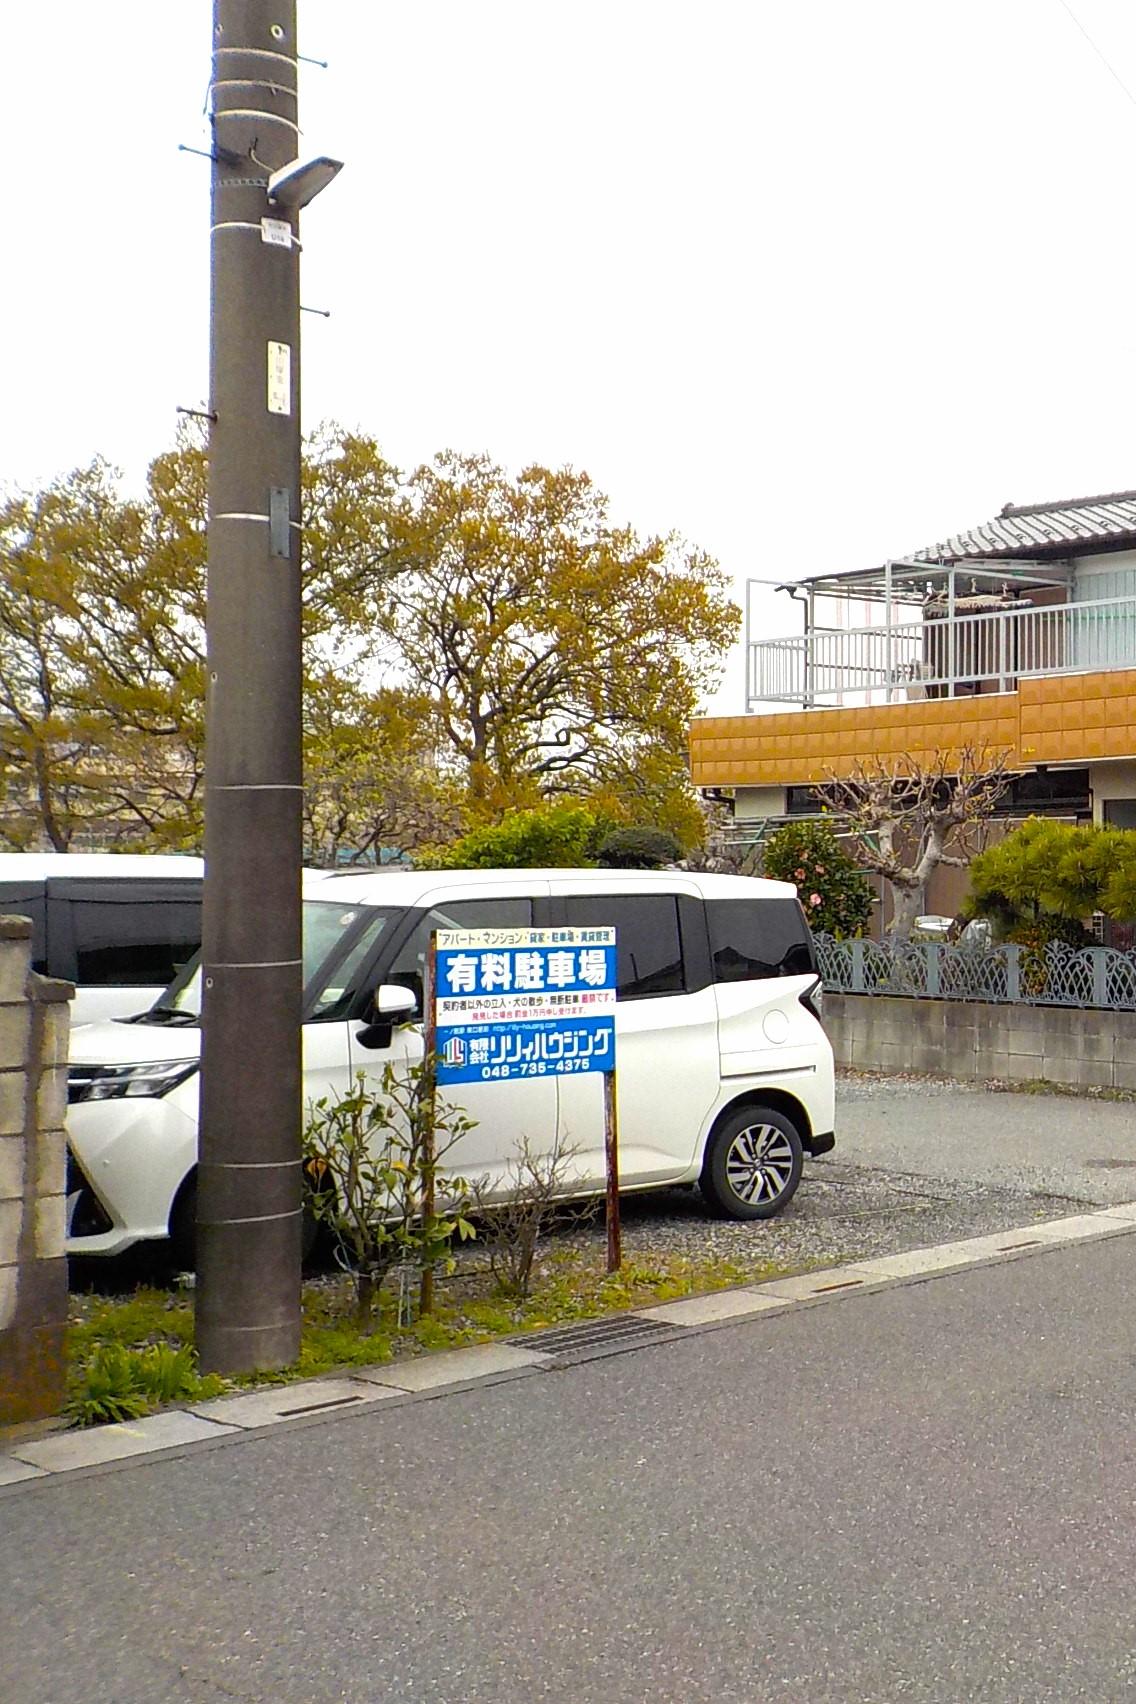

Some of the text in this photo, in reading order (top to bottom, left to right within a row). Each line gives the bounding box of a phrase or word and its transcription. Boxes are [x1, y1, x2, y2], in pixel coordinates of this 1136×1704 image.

[446, 949, 607, 993] 有料駐車場
[469, 1051, 489, 1065] 会社
[481, 1058, 590, 1079] 048-735-4375
